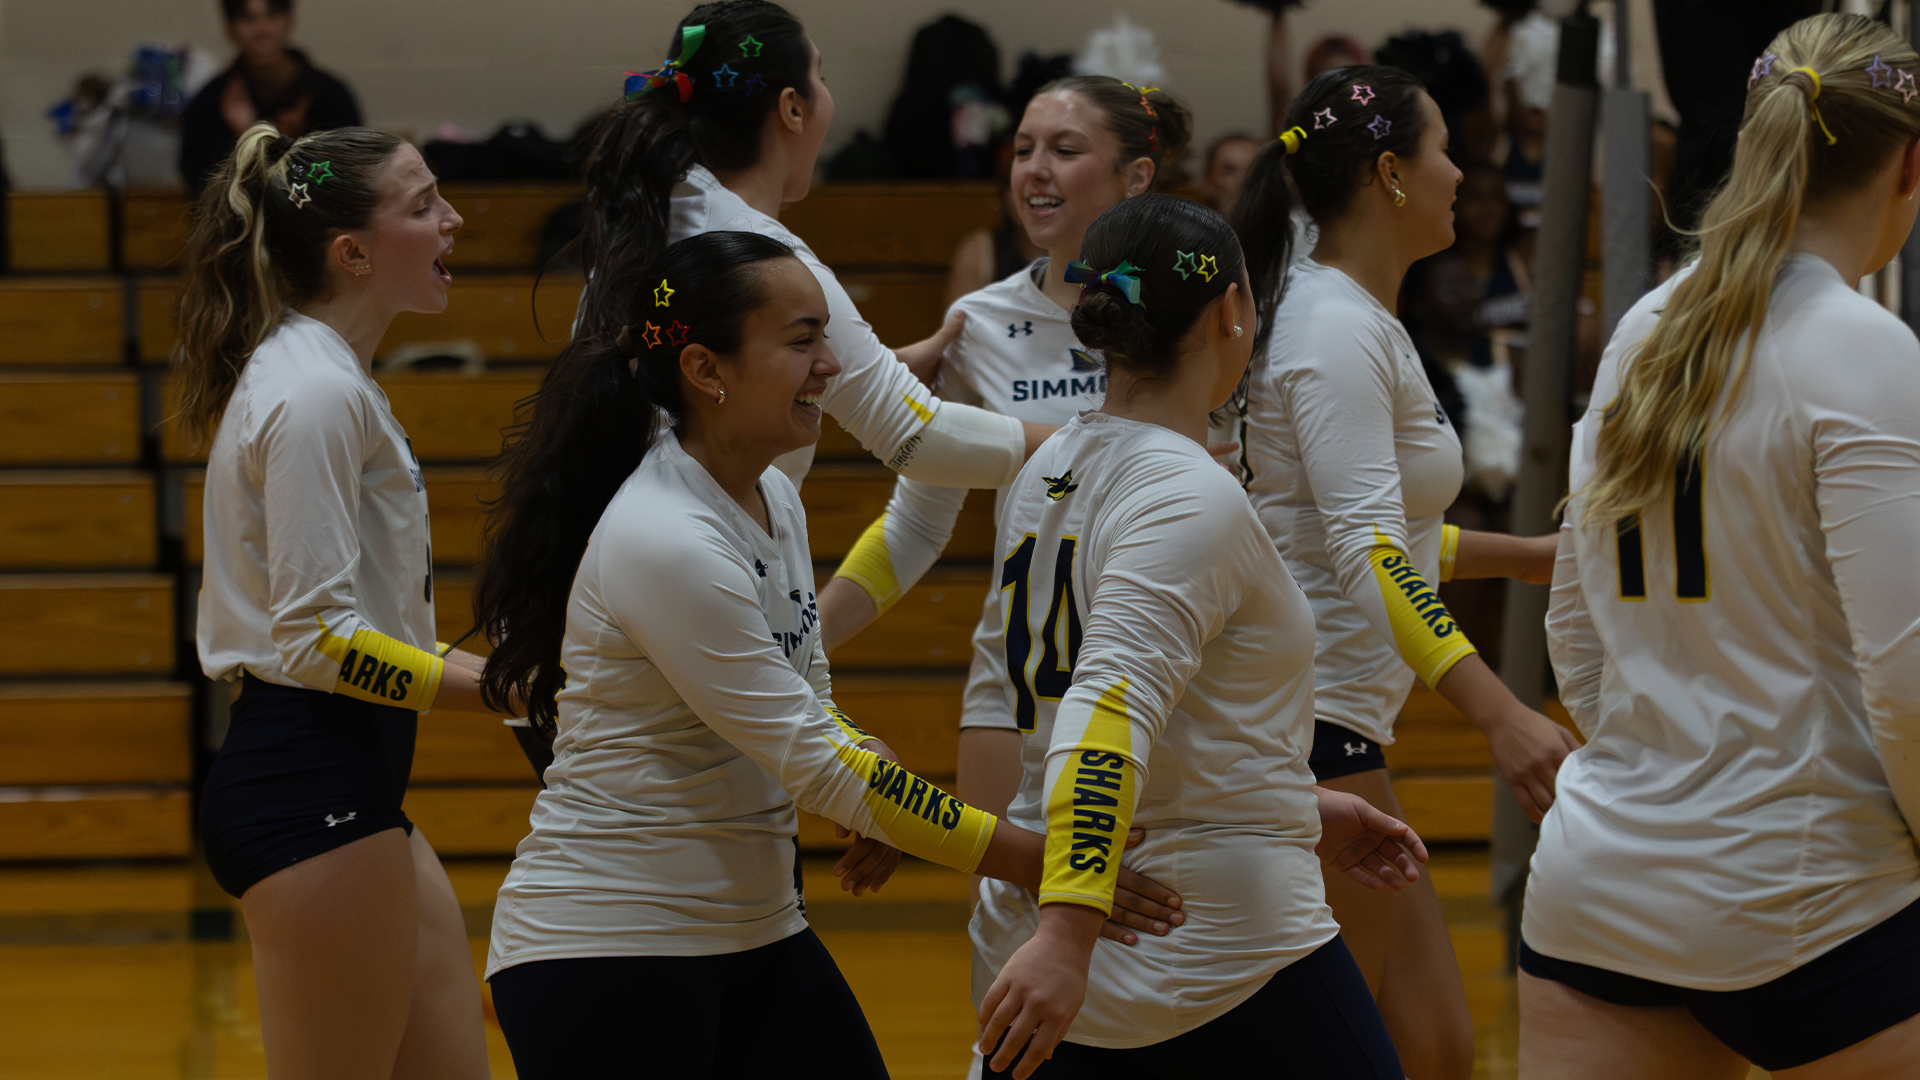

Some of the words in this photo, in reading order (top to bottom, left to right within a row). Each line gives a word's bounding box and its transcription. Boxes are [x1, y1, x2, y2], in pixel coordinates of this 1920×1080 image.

[1000, 532, 1084, 734] 14
[1382, 555, 1461, 638] SHARKS
[340, 648, 413, 701] ARKS
[1069, 750, 1124, 875] SHARKS
